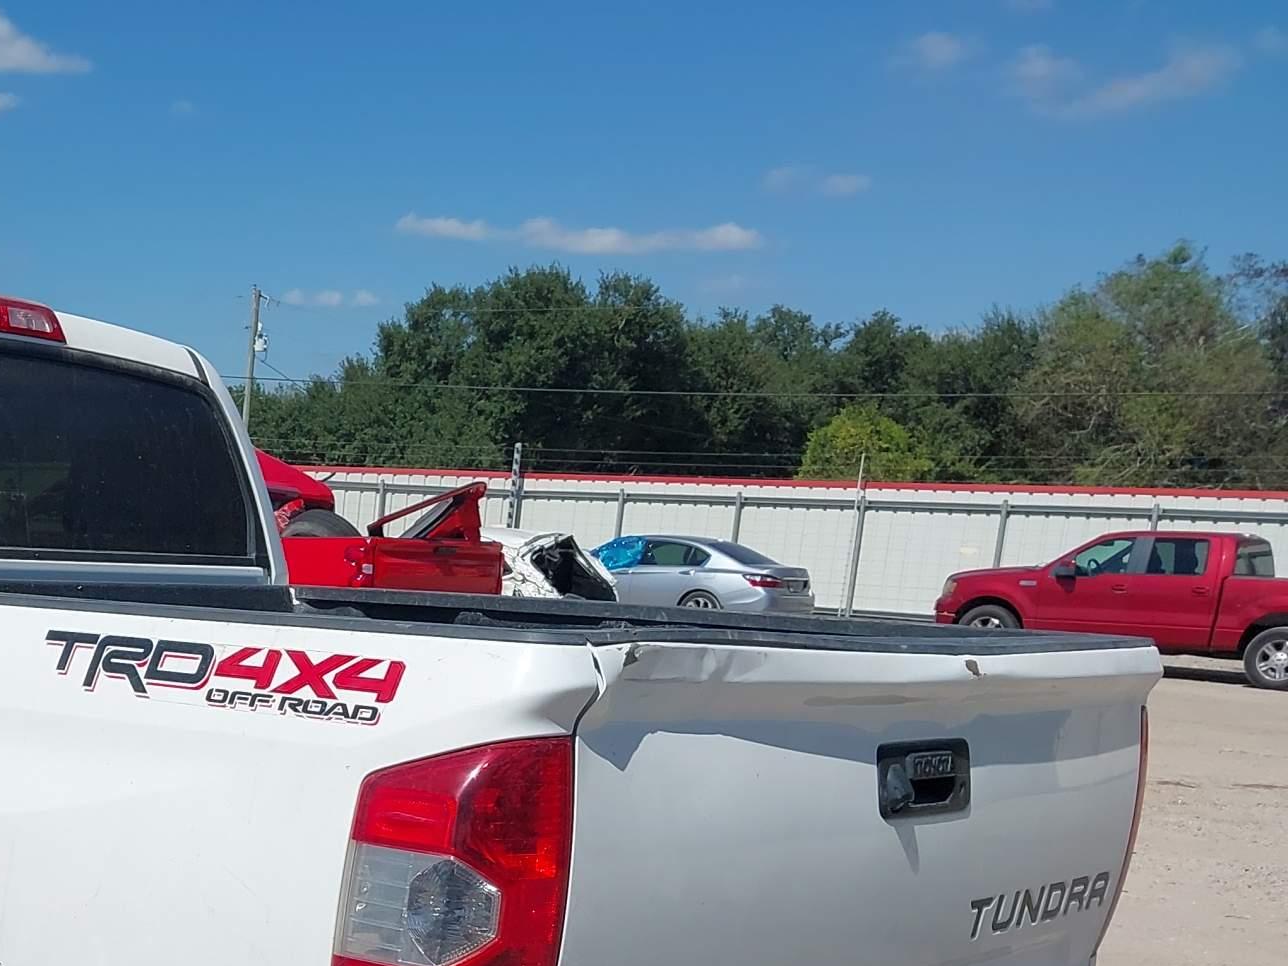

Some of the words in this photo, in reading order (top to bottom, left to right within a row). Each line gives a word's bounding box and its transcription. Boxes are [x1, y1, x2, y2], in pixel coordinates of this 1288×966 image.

[45, 630, 216, 698] TRD
[206, 688, 278, 710] OFF
[278, 695, 382, 725] ROAD
[970, 871, 1110, 940] TUNDRA
